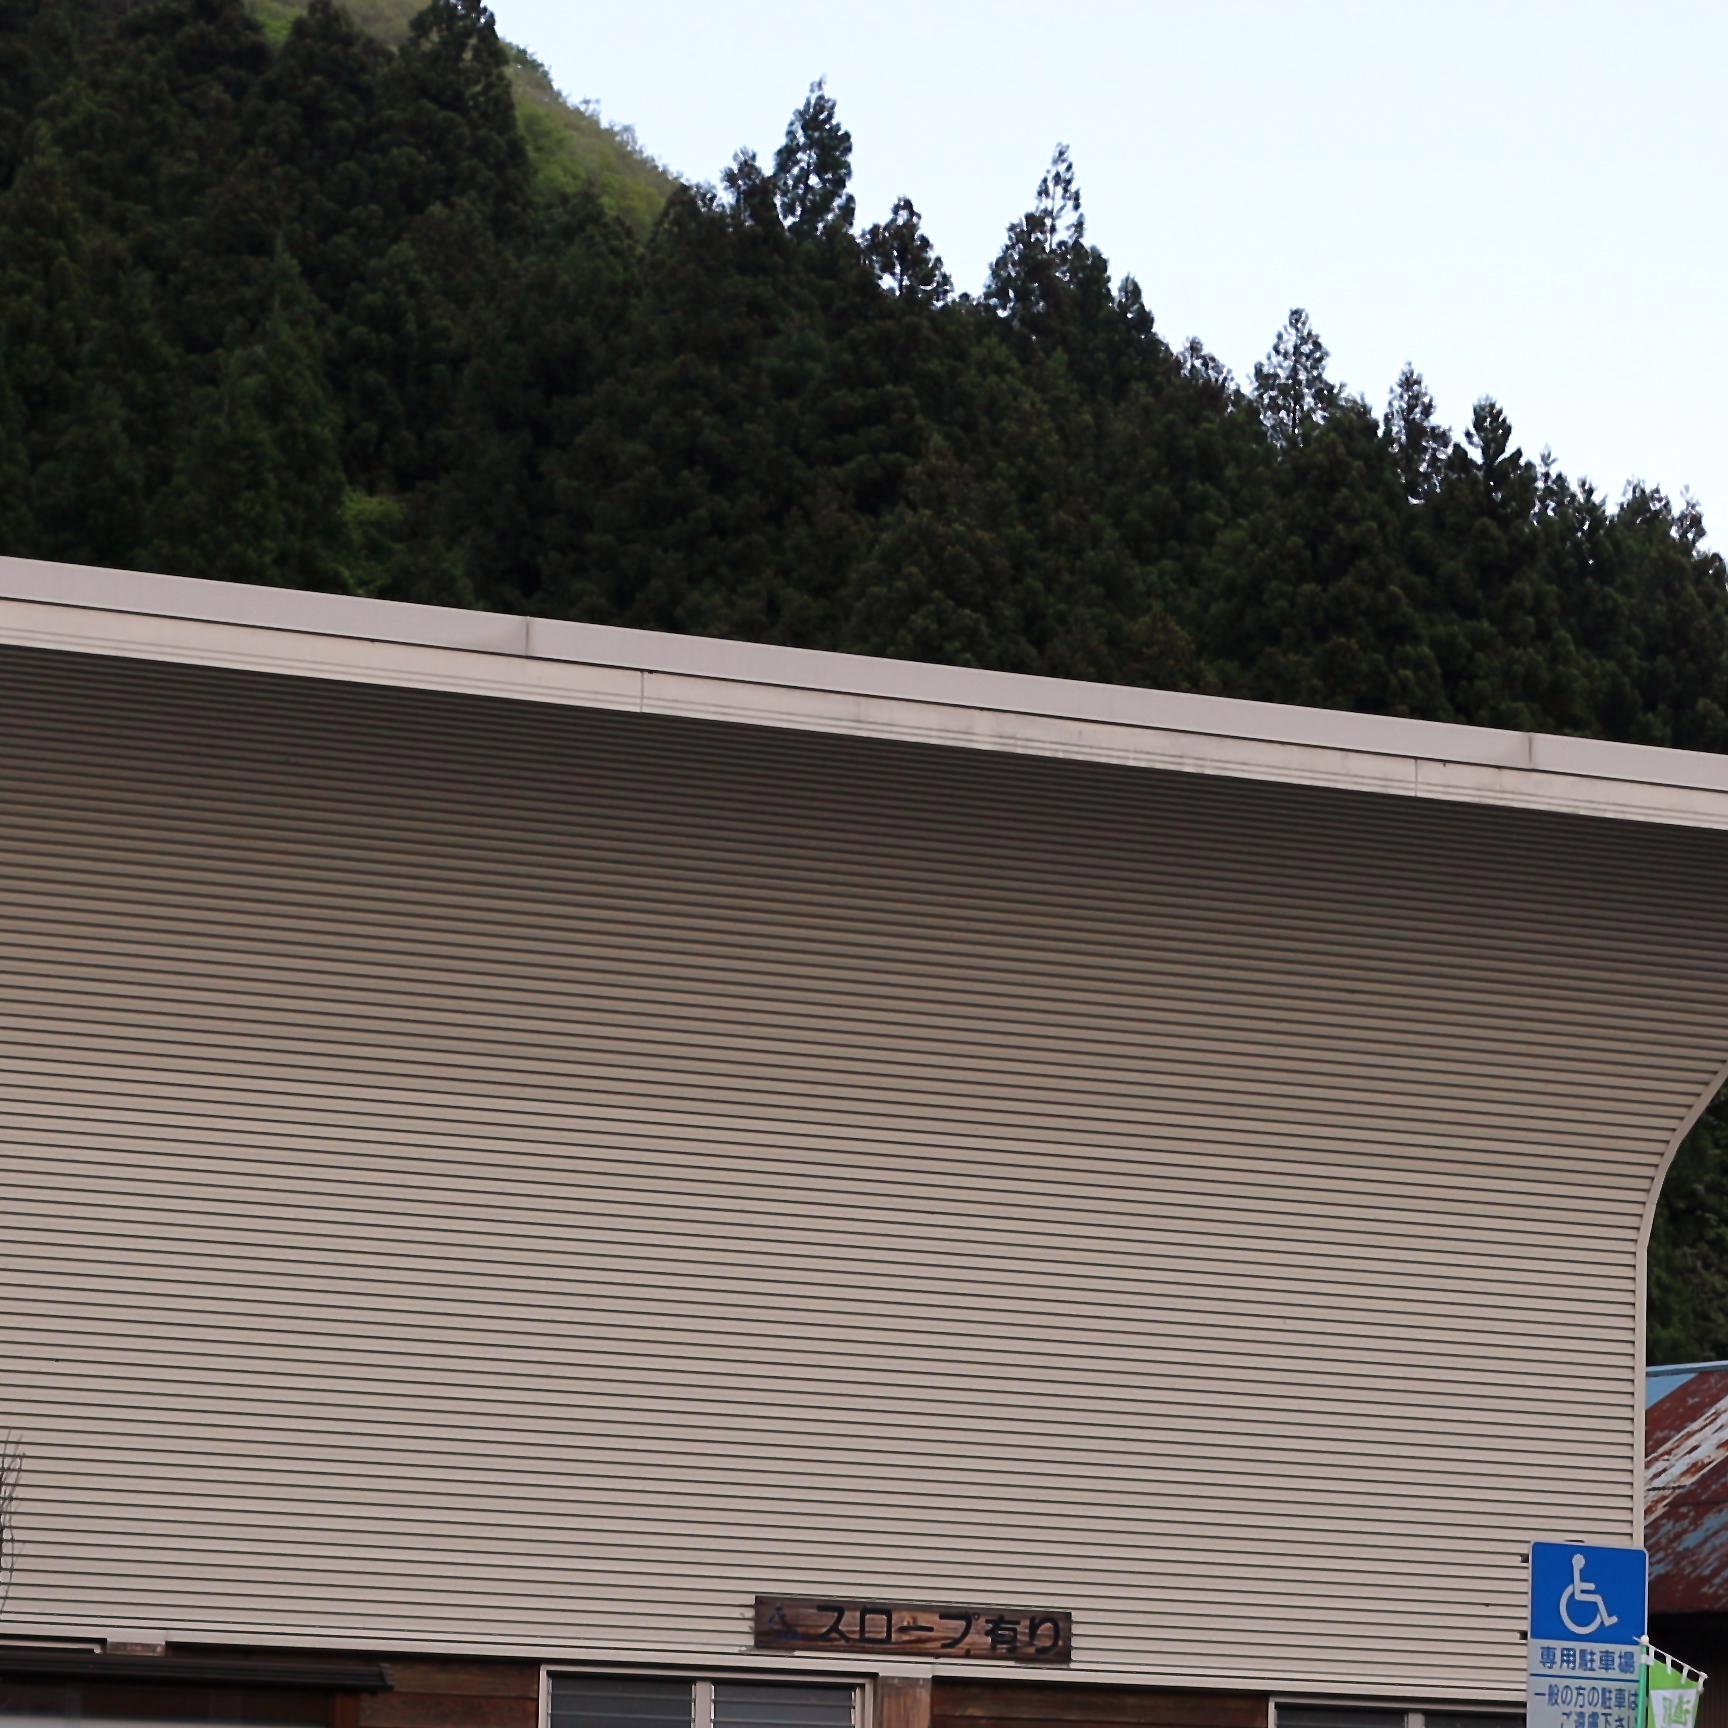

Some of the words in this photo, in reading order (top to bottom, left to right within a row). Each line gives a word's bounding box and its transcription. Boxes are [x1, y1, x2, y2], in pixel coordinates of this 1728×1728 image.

[816, 1604, 1061, 1655] スロープ有り
[1539, 1646, 1635, 1674] 専用駐車場
[1534, 1684, 1639, 1711] 一般の方の駐車は
